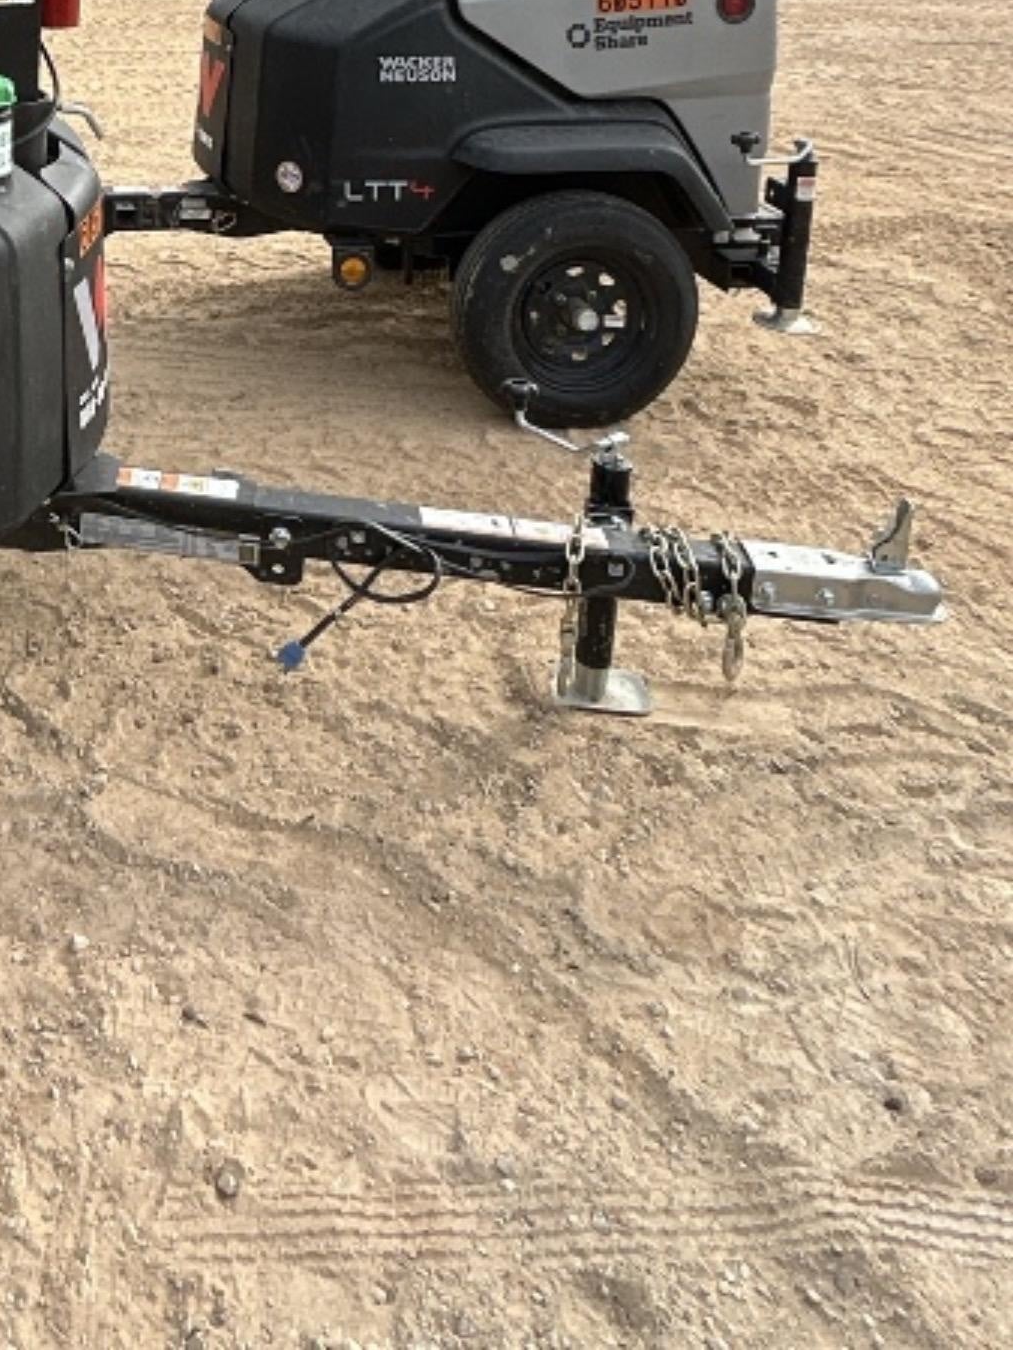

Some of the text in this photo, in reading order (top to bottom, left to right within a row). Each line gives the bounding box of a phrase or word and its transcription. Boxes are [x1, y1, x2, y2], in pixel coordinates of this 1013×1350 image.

[593, 11, 694, 34] Equipment
[378, 55, 456, 70] WACKER
[379, 68, 457, 83] NEUSON
[343, 179, 435, 202] LTT4
